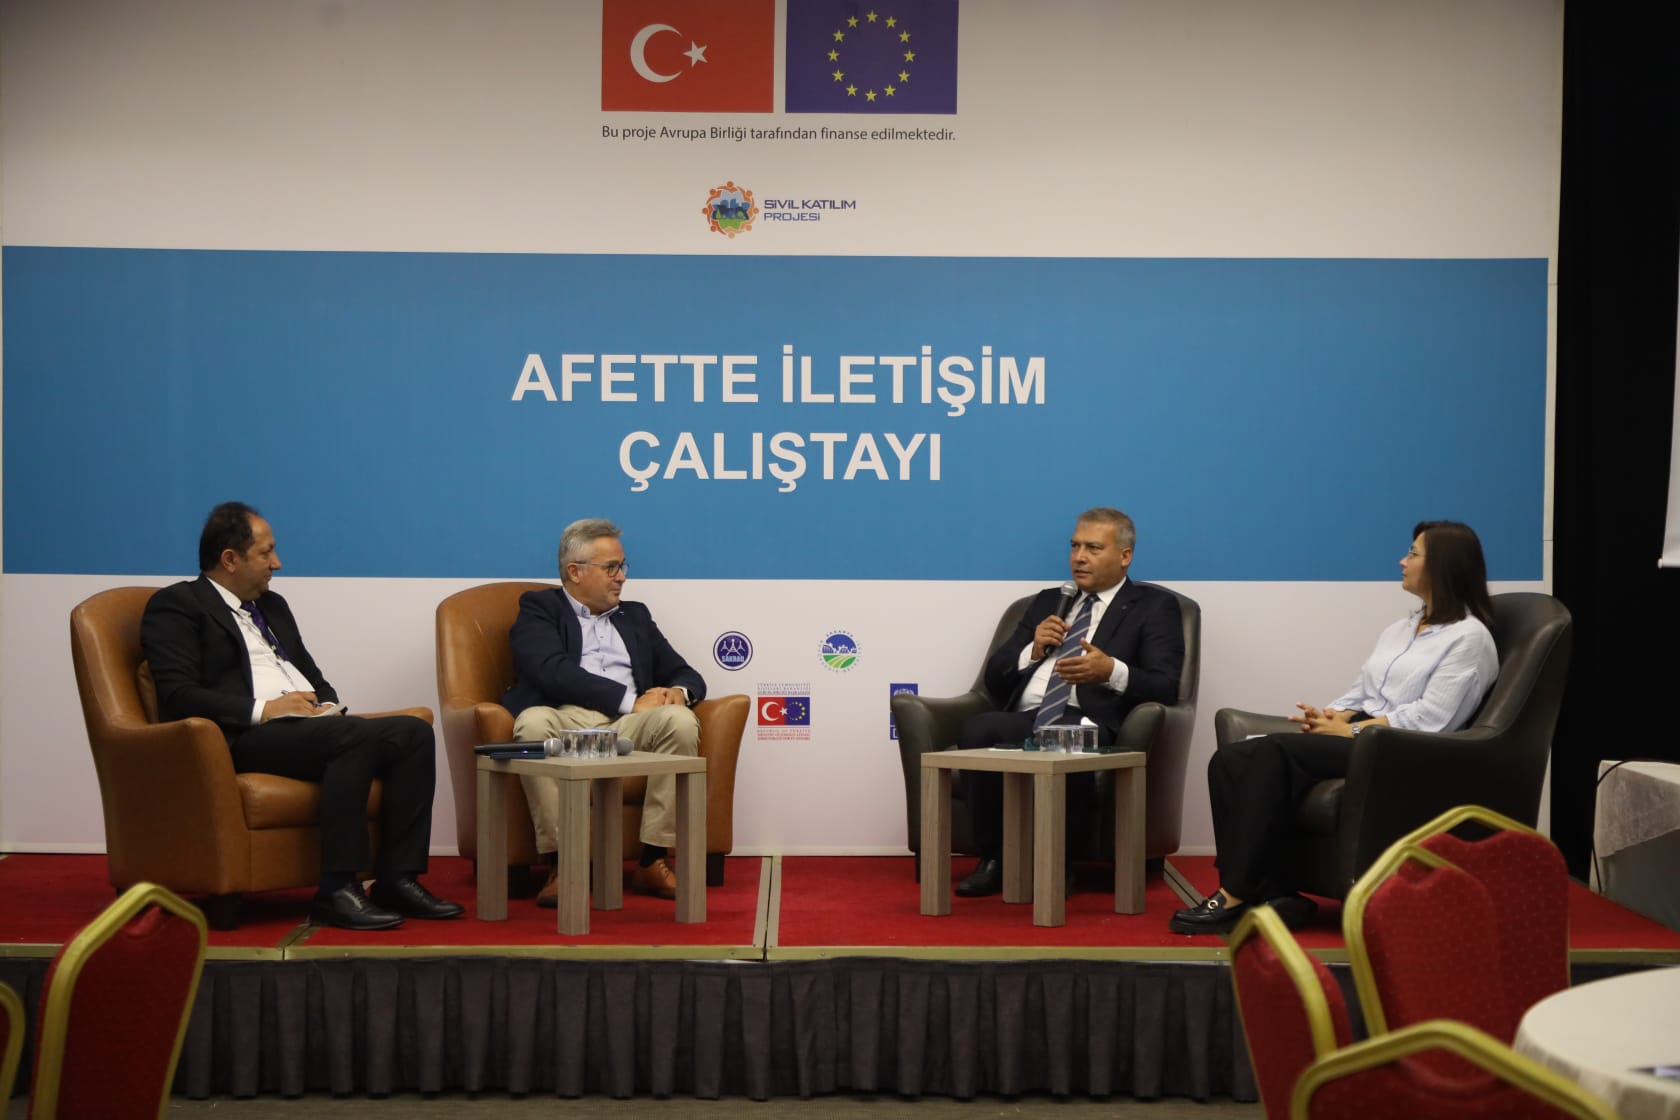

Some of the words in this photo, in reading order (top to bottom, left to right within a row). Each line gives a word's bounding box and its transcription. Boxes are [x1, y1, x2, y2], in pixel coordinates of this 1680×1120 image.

[602, 126, 618, 138] Bu
[623, 126, 656, 142] proje
[660, 126, 706, 142] Avrupa
[711, 127, 746, 143] Birliği
[750, 127, 816, 140] tarafından
[821, 127, 867, 140] finanse
[871, 128, 955, 141] edilmektedir.
[512, 354, 758, 402] AFETTE
[783, 345, 1045, 416] İLETİŞİM
[620, 431, 940, 492] ÇALIŞTAYI
